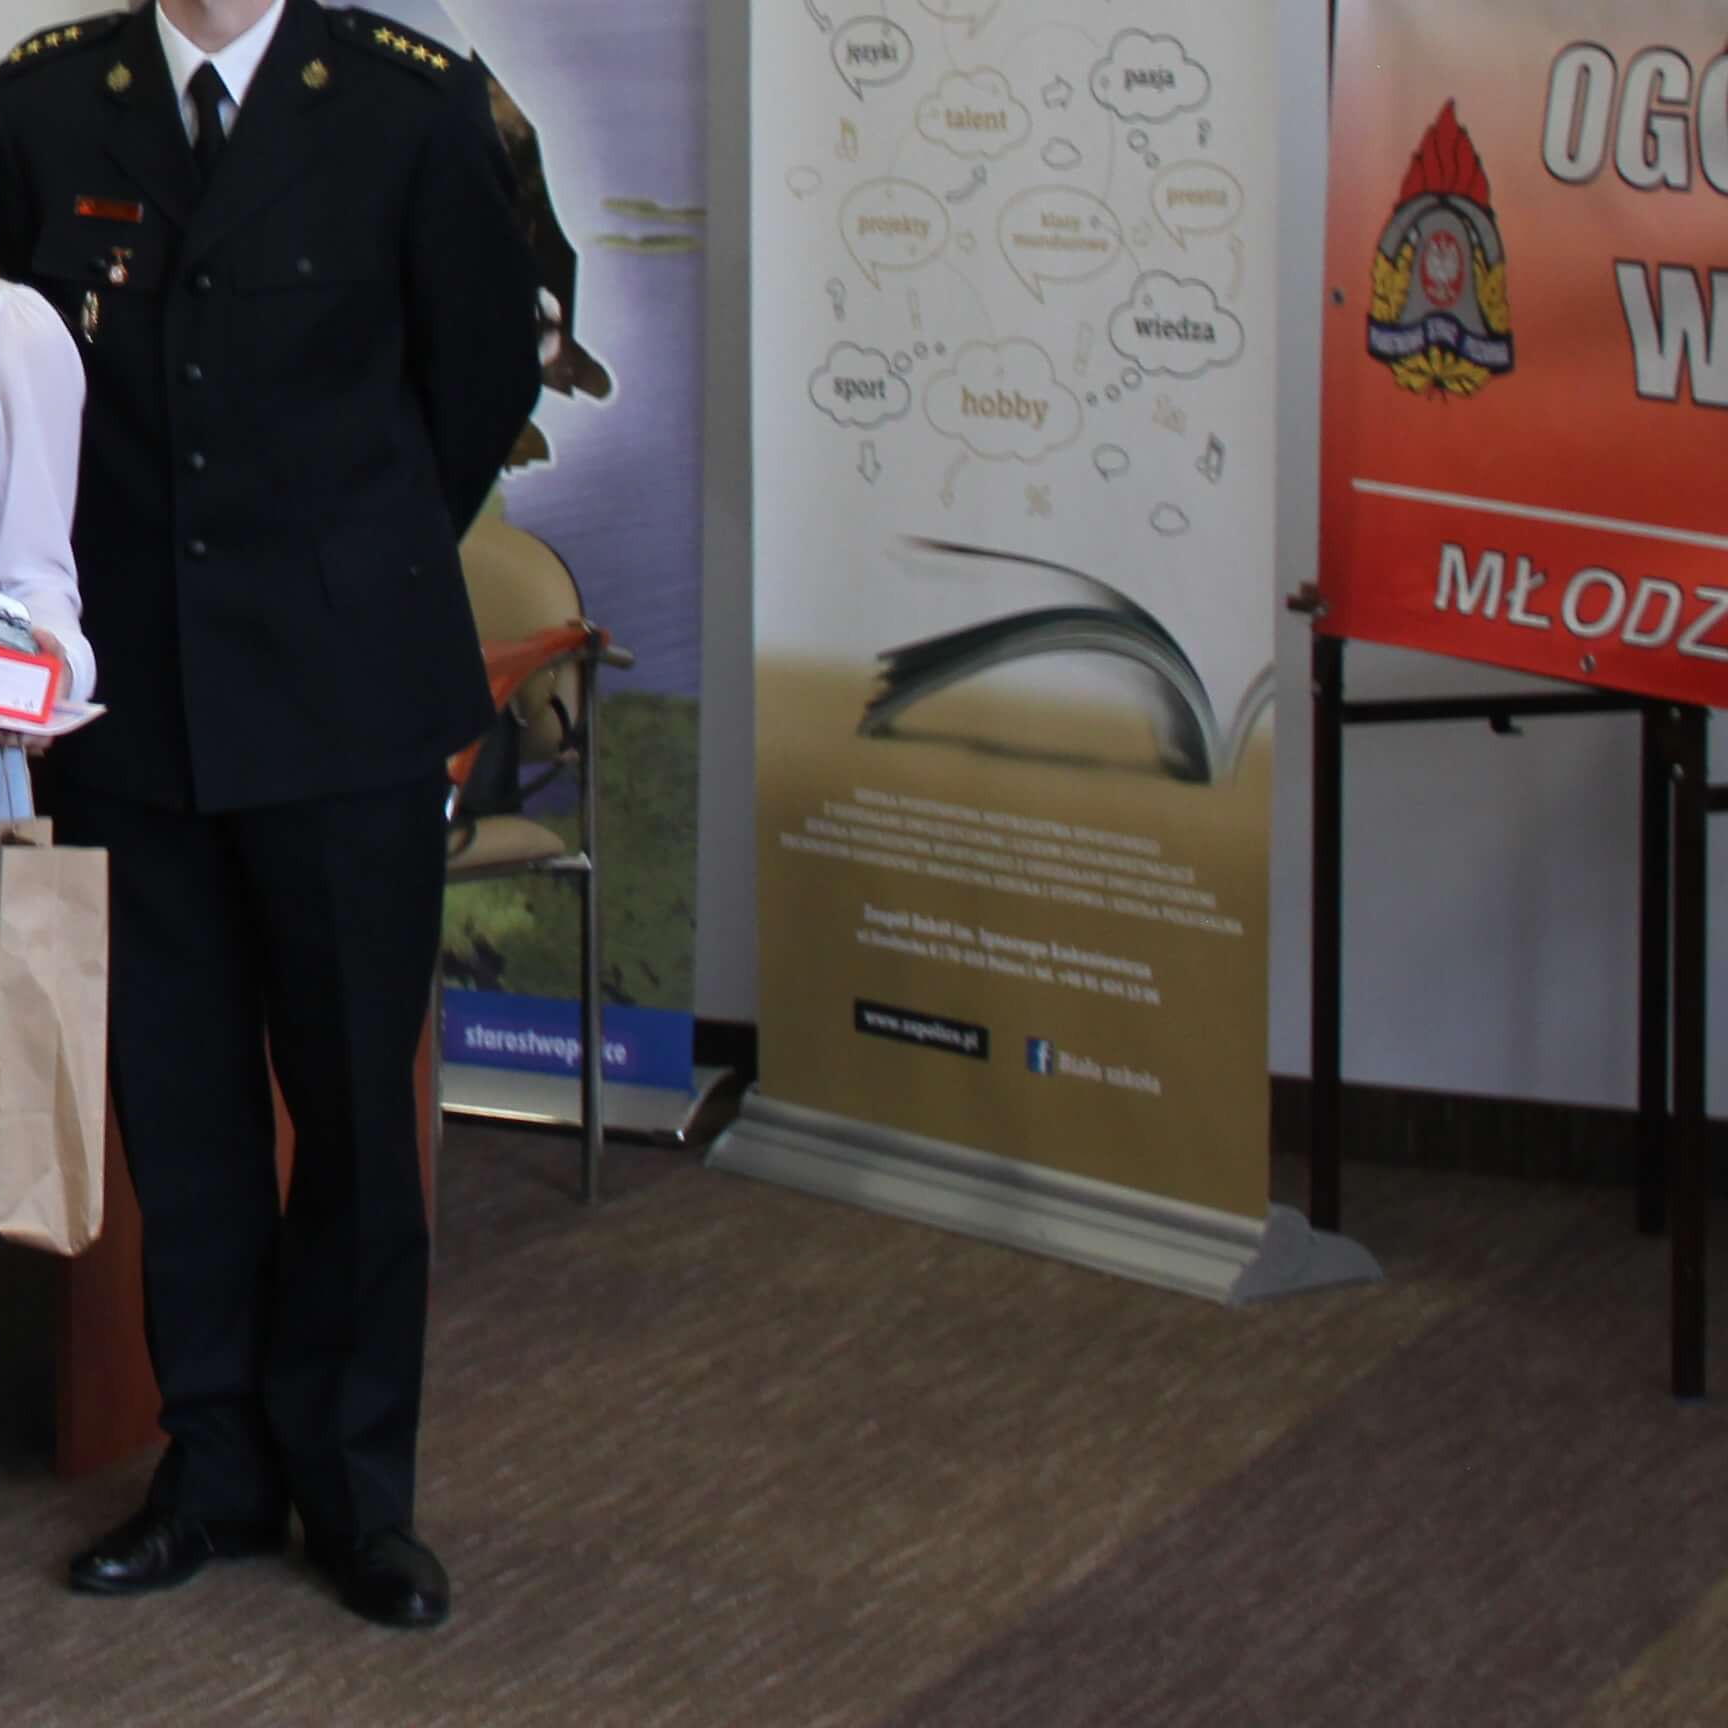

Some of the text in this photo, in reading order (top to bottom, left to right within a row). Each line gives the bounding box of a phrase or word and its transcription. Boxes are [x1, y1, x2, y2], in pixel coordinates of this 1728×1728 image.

[1134, 312, 1215, 342] wiedza
[833, 376, 887, 404] sport
[961, 387, 1049, 430] hobby
[1433, 541, 1728, 663] MŁODZ
